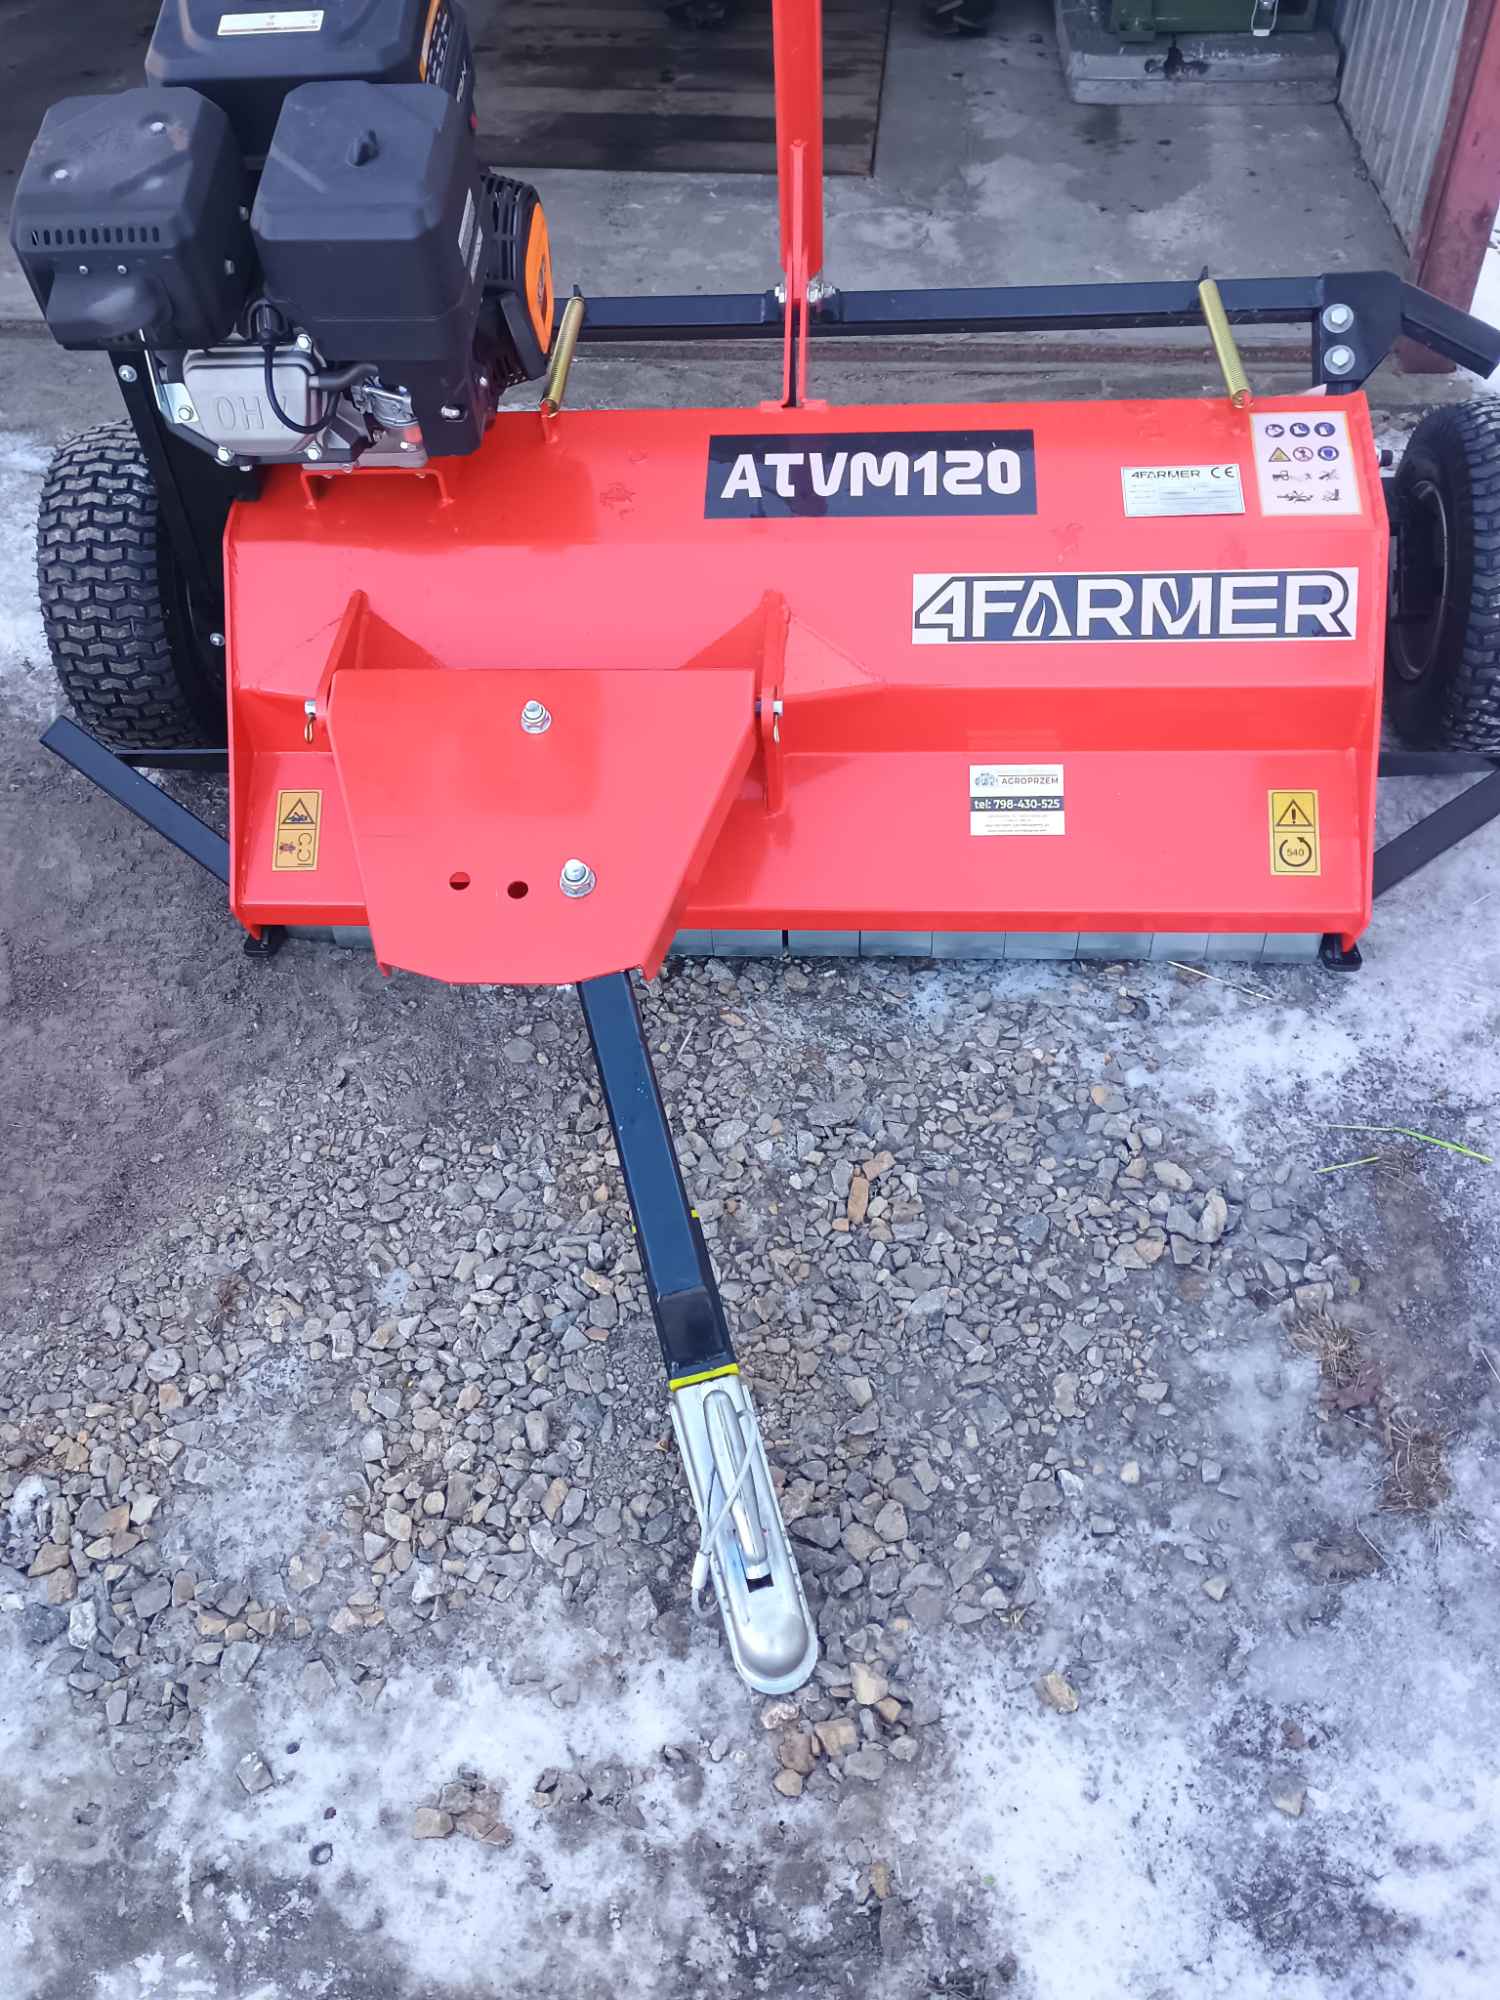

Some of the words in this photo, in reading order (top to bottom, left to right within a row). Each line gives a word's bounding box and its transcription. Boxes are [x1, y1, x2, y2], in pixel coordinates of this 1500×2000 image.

[720, 448, 1021, 499] ATVM120
[1131, 470, 1200, 479] 4FARMER
[917, 573, 1347, 639] 4FARMER
[974, 799, 992, 809] tel:
[994, 799, 1060, 809] 798-430-525
[1287, 847, 1304, 856] 540
